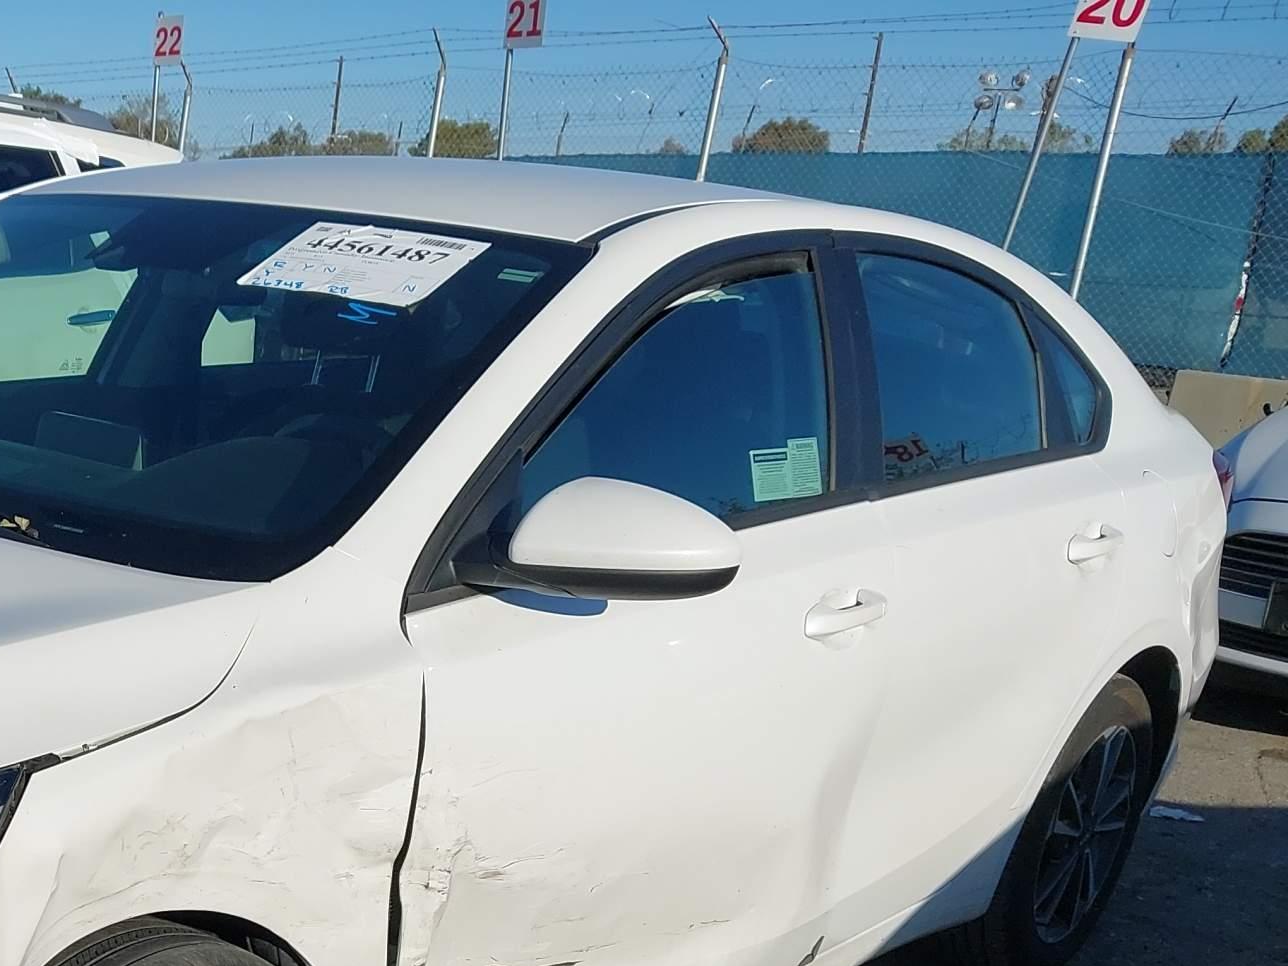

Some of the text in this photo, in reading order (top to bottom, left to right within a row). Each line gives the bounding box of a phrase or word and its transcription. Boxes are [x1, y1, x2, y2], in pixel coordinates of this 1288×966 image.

[506, 0, 542, 38] 21
[154, 26, 182, 57] 22
[306, 236, 450, 265] 44561487
